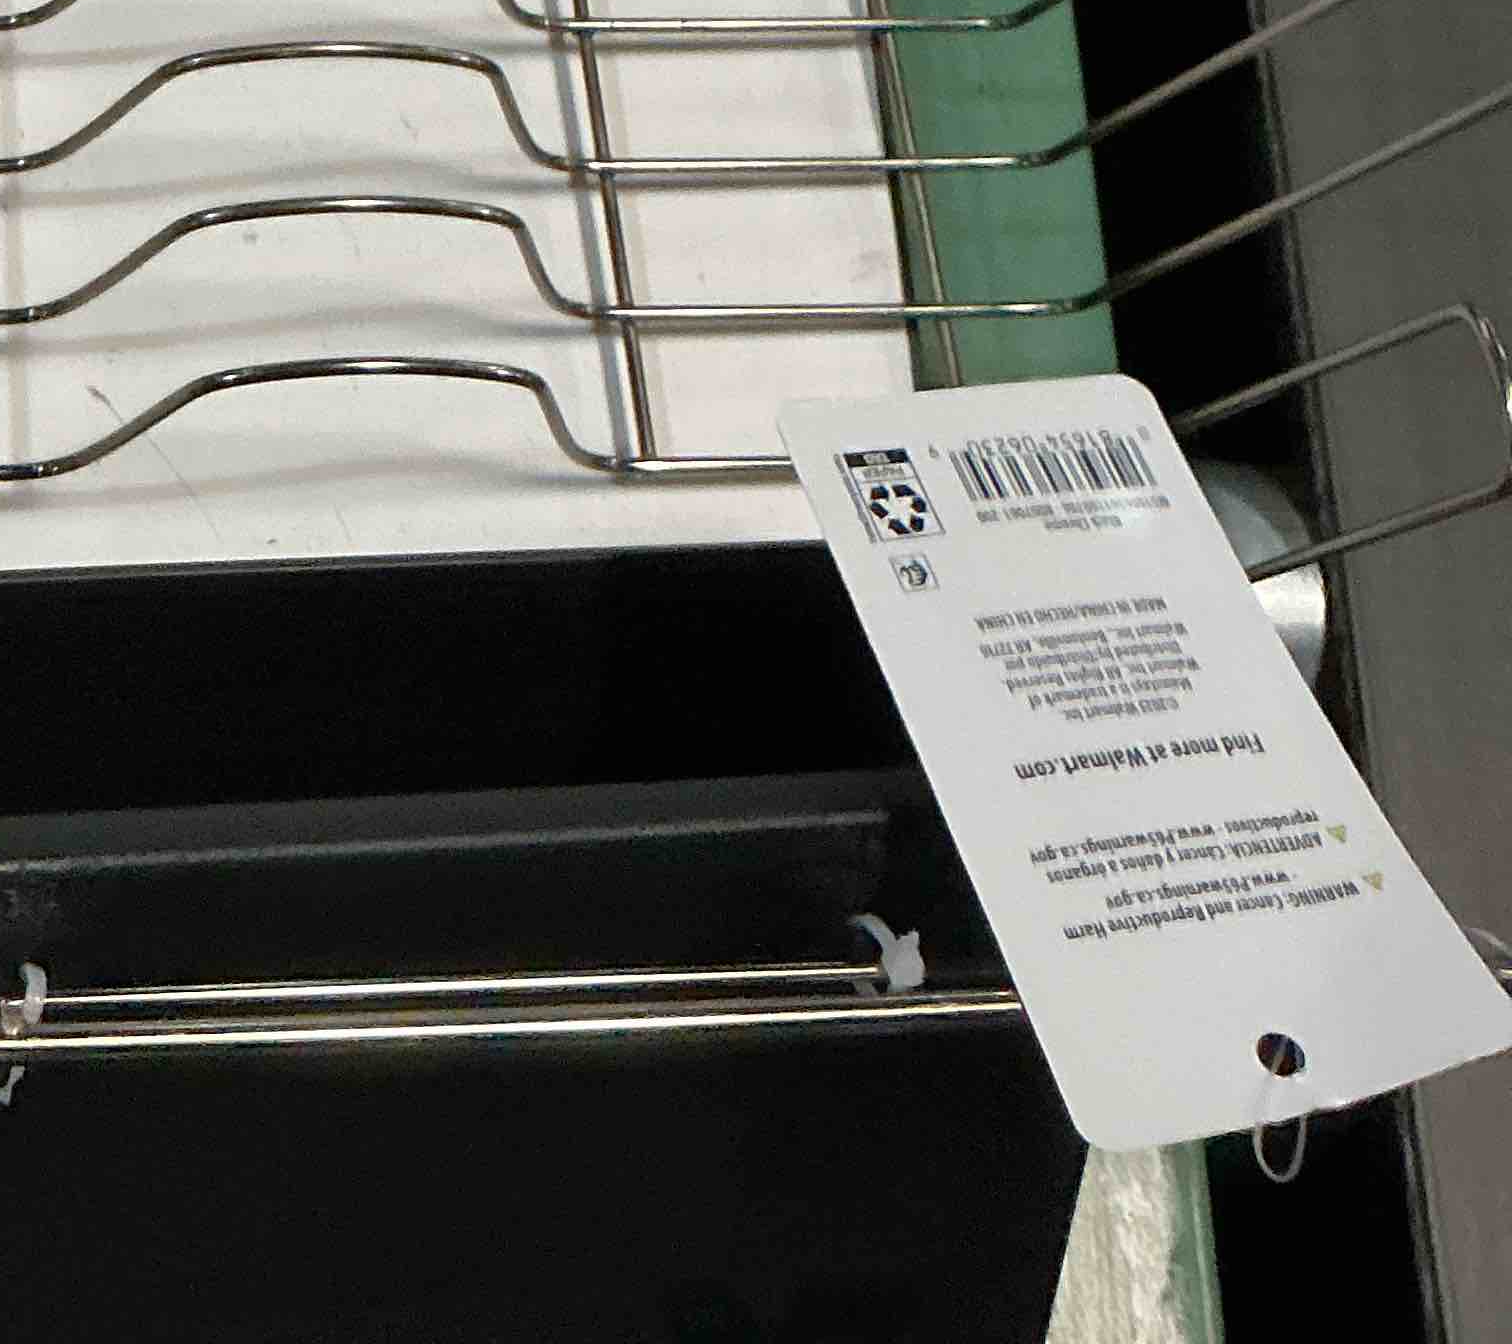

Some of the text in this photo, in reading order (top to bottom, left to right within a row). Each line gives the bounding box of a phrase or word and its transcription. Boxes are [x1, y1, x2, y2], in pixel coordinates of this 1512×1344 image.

[1014, 731, 1265, 780] Find more at Walmart.com
[1205, 900, 1234, 920] and
[1238, 894, 1284, 912] Cancer
[1110, 902, 1205, 932] Reproductive
[1063, 918, 1108, 940] Harm
